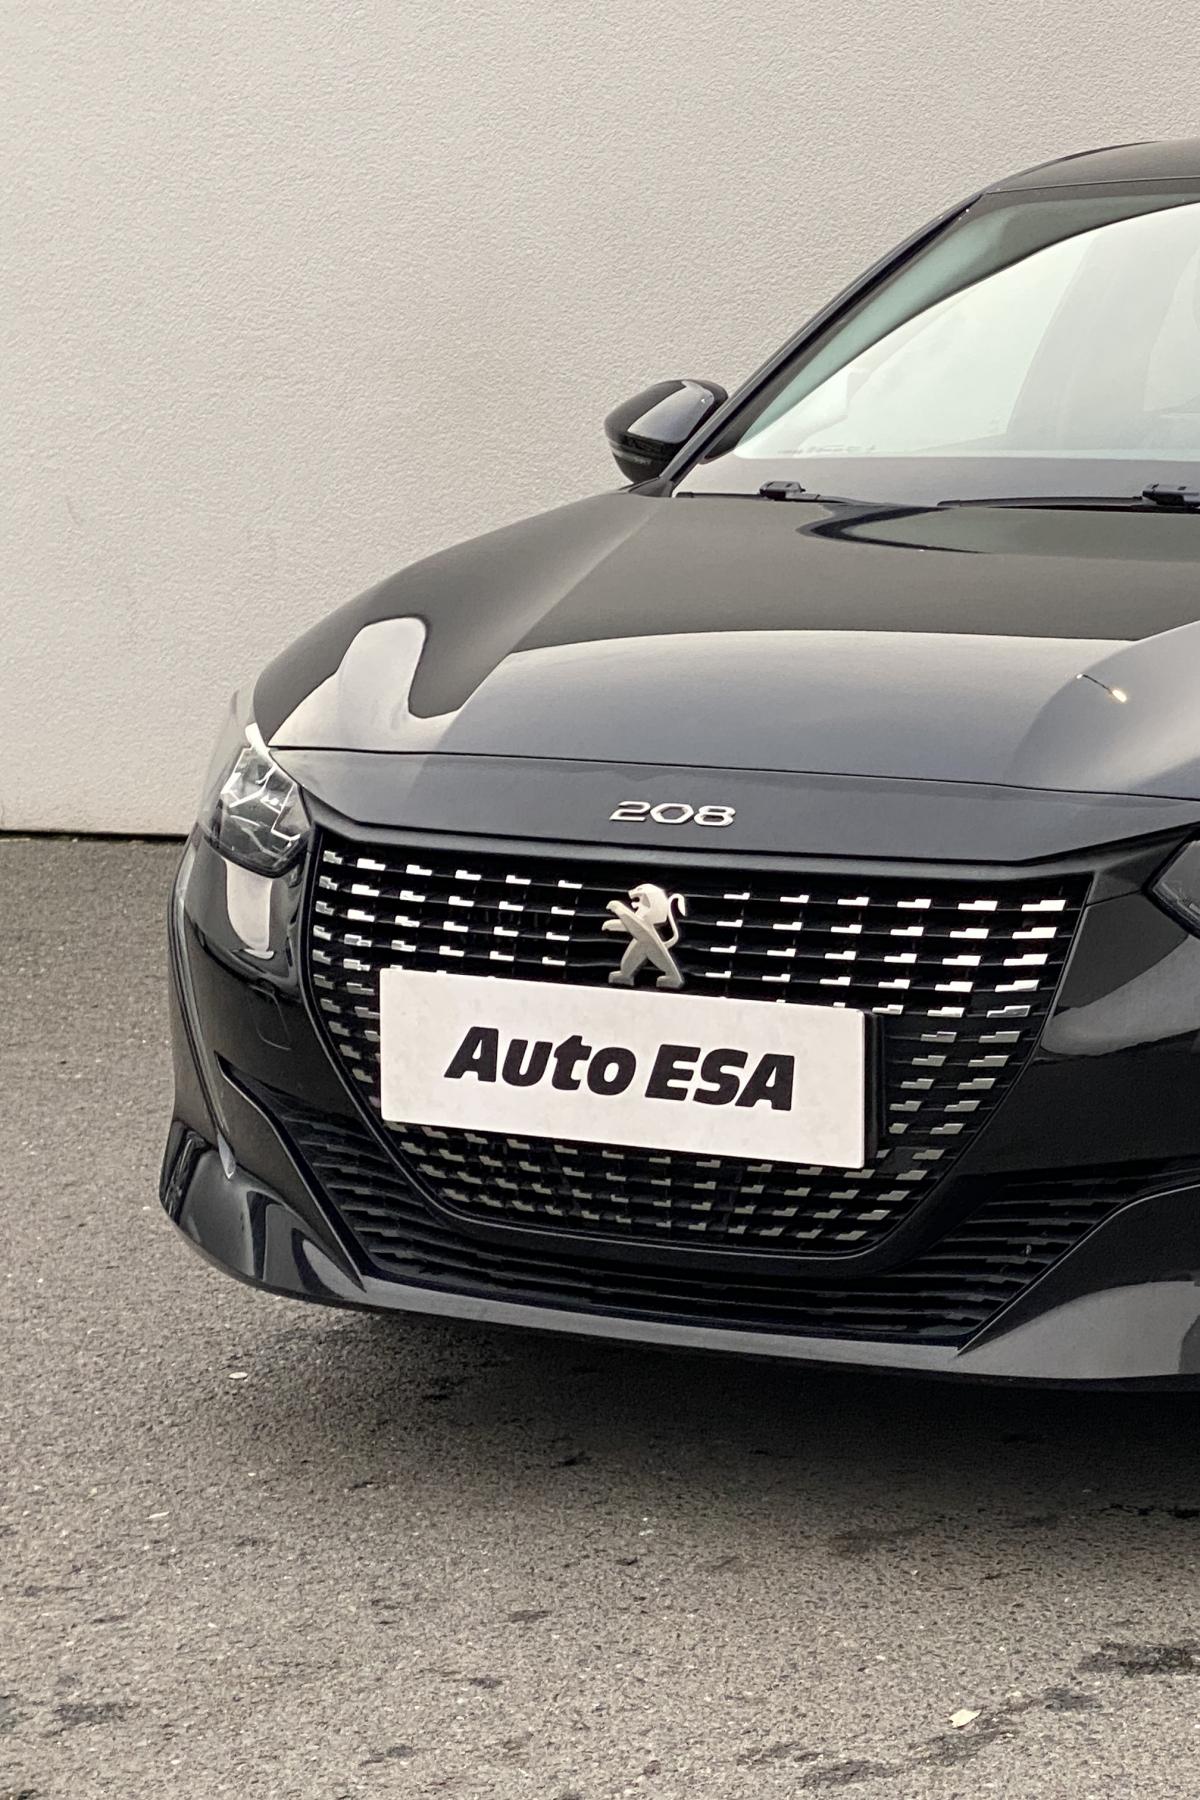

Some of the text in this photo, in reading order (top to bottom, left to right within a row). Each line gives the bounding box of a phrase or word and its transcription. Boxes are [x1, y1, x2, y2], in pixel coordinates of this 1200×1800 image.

[609, 800, 736, 826] 208
[444, 1026, 795, 1112] Auto ESA
